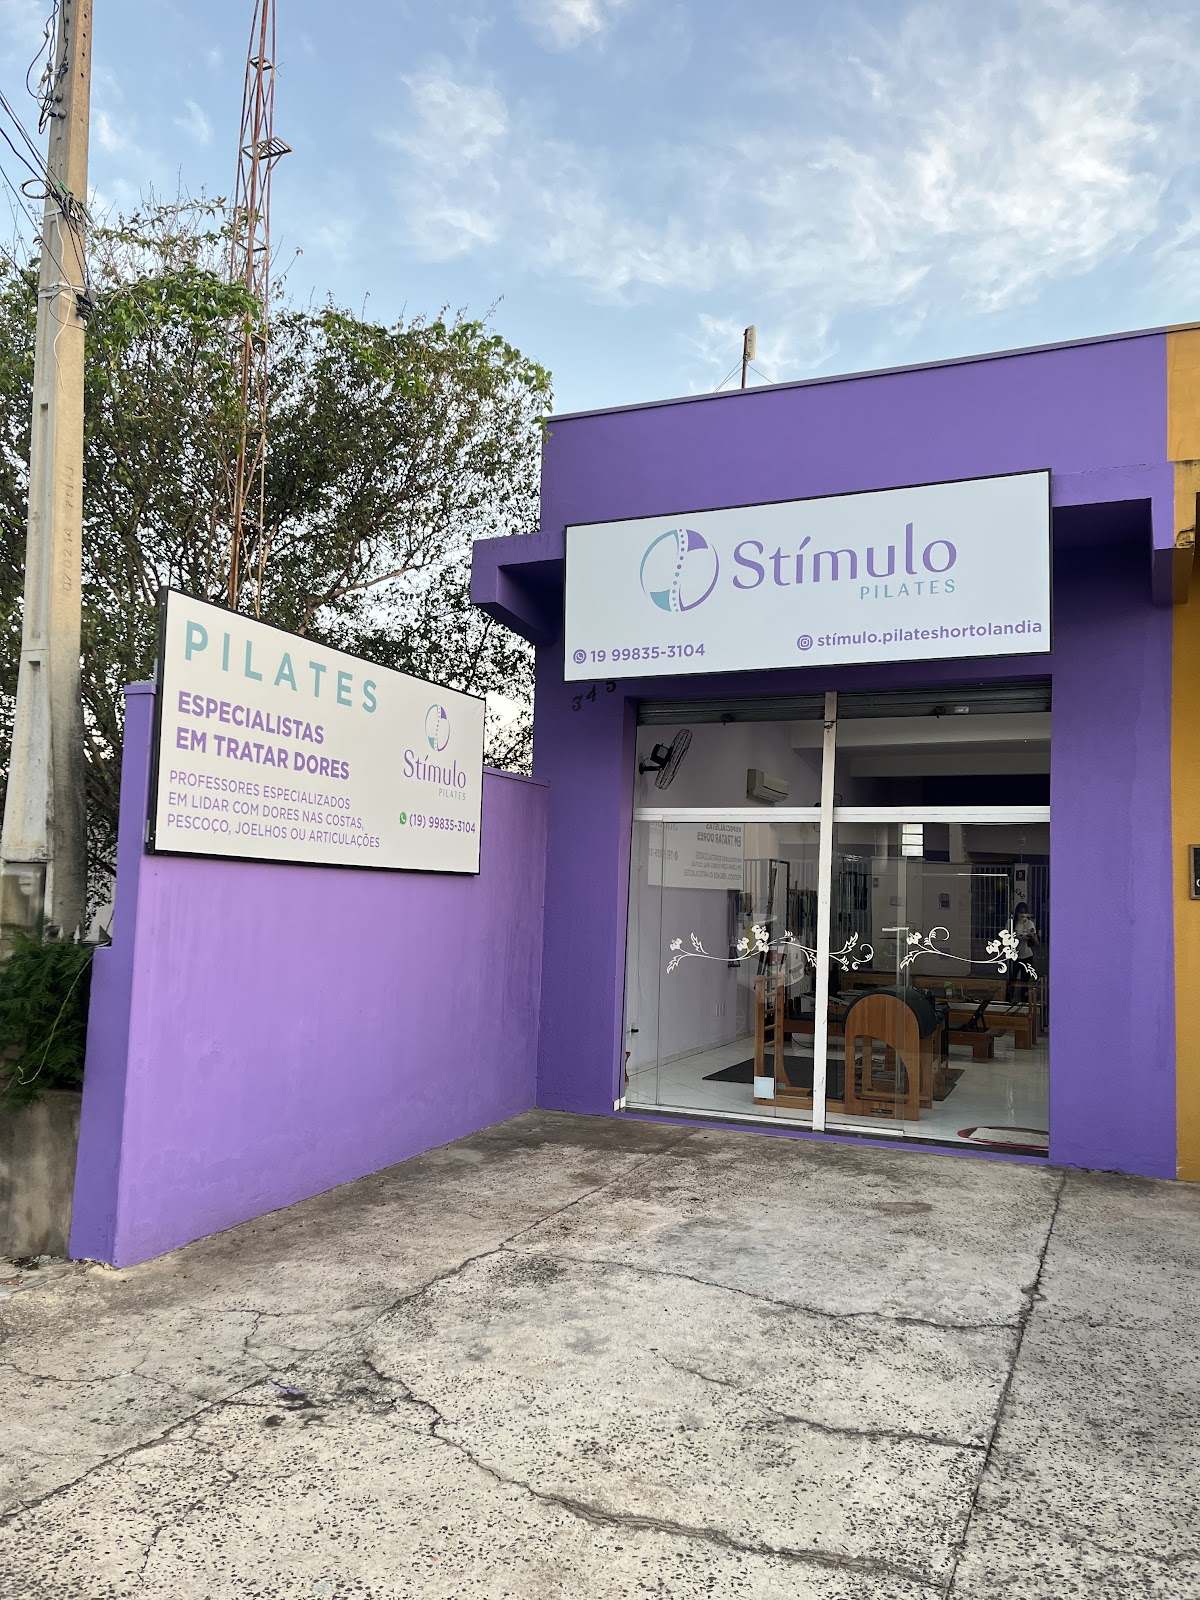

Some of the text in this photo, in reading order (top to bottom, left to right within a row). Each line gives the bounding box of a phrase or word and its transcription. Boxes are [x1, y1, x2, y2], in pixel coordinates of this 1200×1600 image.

[733, 523, 957, 589] Stímulo
[860, 578, 956, 600] PILATES
[590, 643, 706, 663] 19 99835-3104
[817, 619, 1042, 648] stímulo.pilateshortolandia
[184, 620, 378, 713] PILATES
[177, 690, 325, 744] ESPECIALISTAS
[176, 726, 350, 780] EM TRATAR DORES
[403, 749, 467, 789] Stímulo
[169, 769, 351, 810] PROFESSORES ESPECIALIZADOS
[438, 787, 466, 801] PILATES
[167, 813, 380, 848] PESCOÇO, JOELHOS OU ARTICULAÇÕES
[168, 791, 365, 831] EM LIDAR COM DORES NAS COSTAS,
[409, 813, 476, 834] (19) 99835-3104
